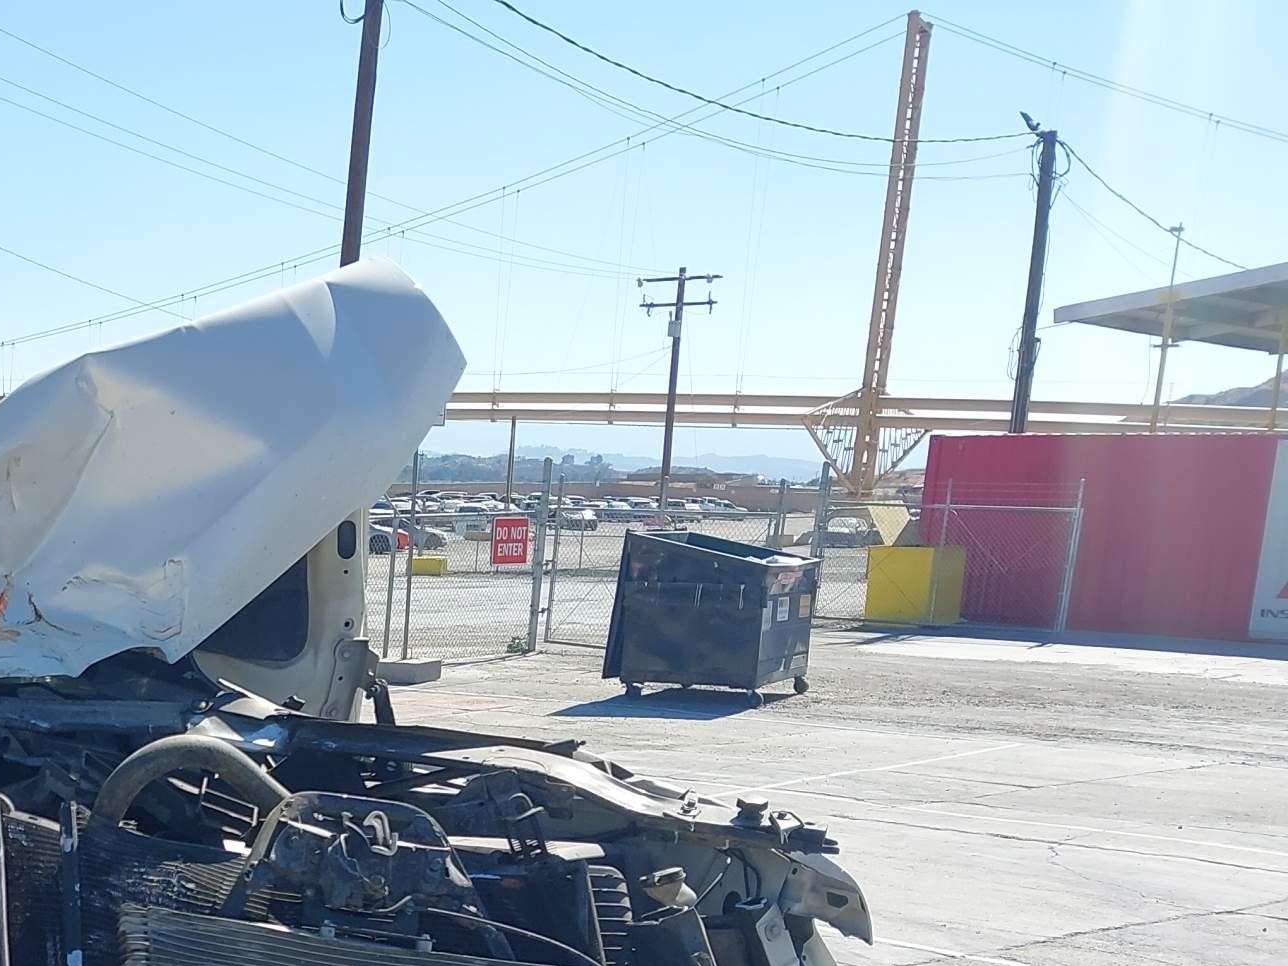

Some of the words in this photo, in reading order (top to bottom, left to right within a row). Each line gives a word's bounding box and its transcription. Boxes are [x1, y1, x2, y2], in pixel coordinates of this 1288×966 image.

[496, 526, 508, 540] DO
[511, 526, 528, 540] NOT
[497, 543, 524, 557] ENTER
